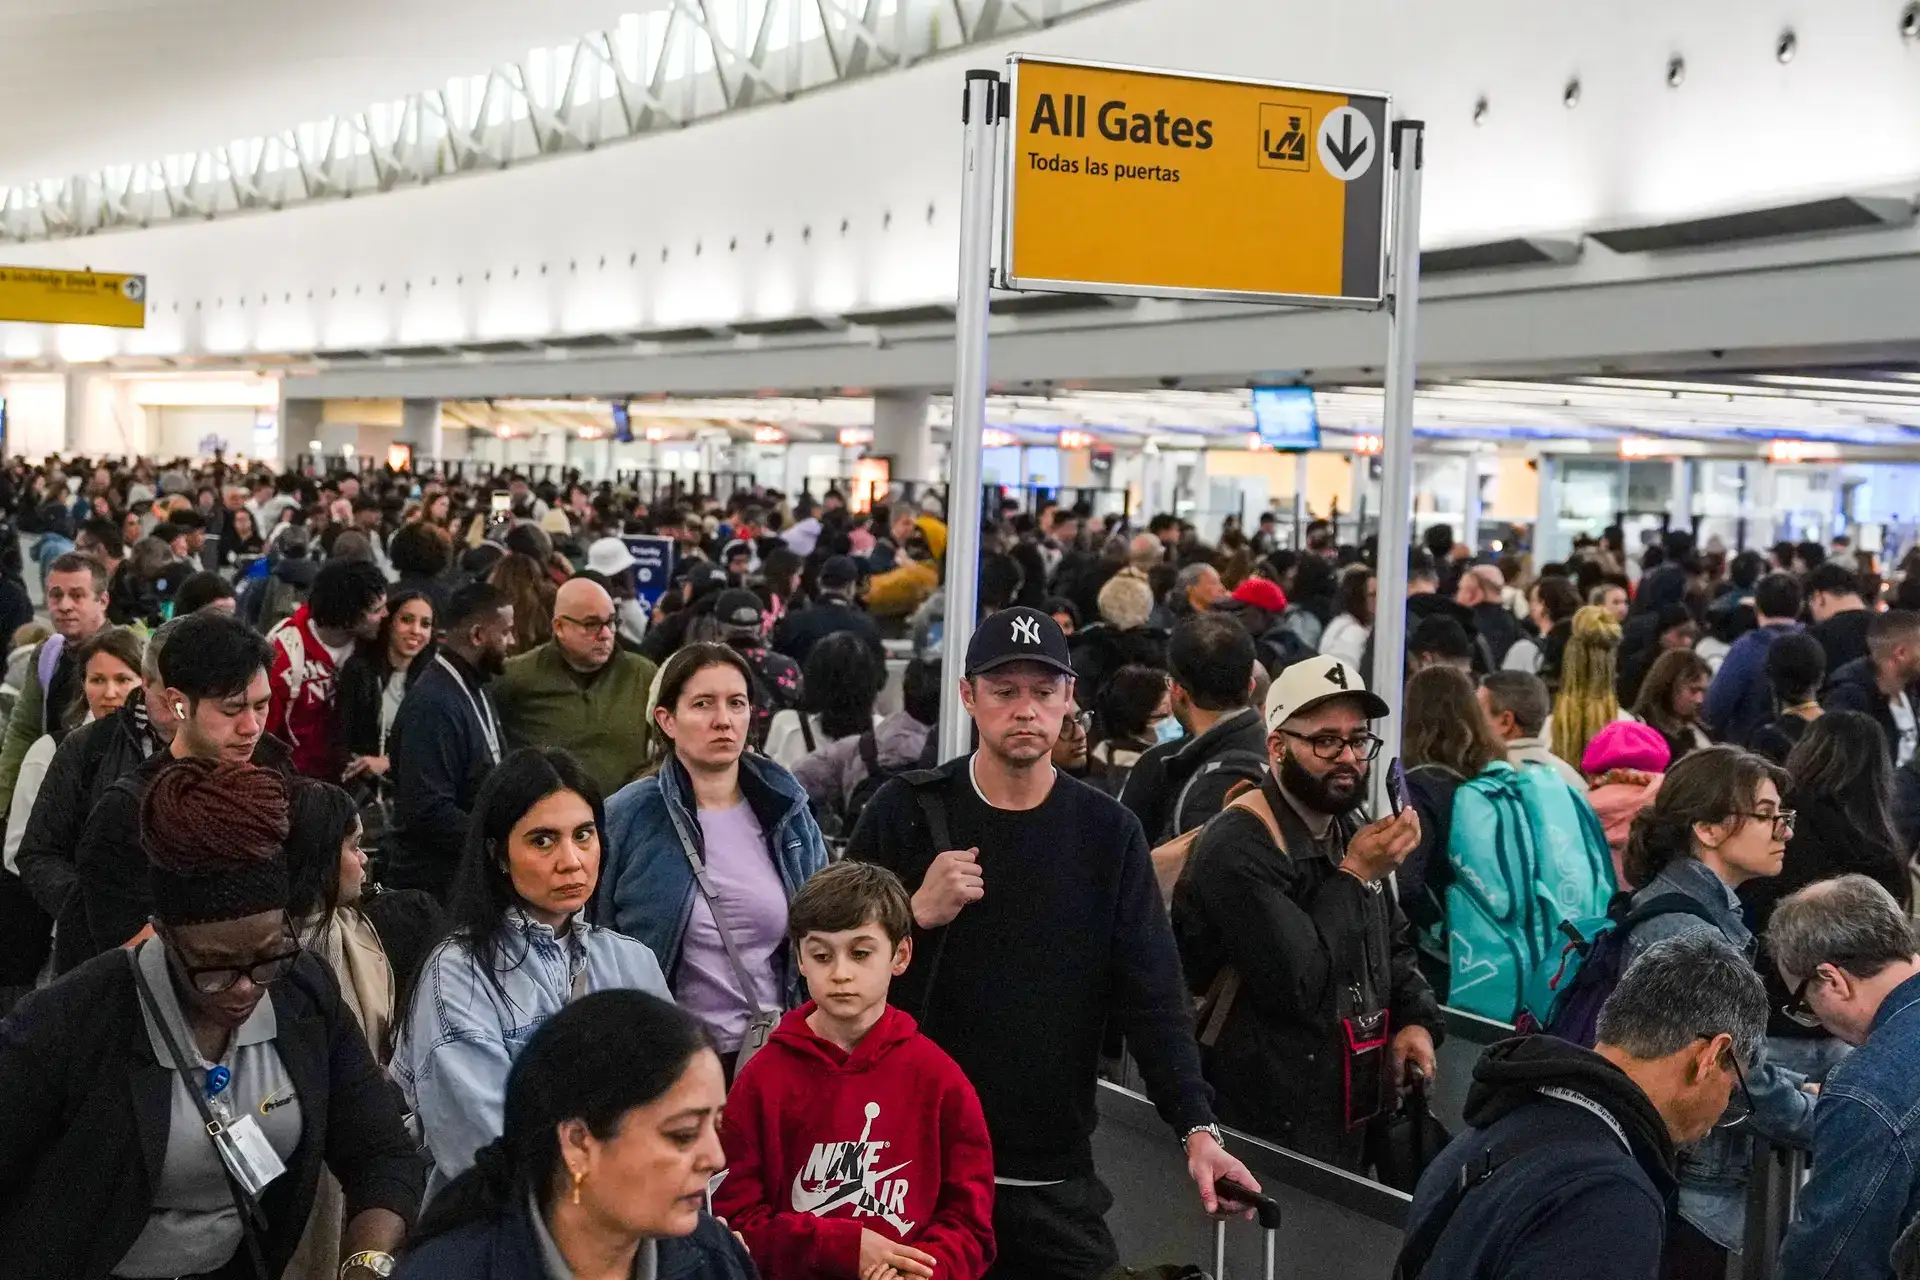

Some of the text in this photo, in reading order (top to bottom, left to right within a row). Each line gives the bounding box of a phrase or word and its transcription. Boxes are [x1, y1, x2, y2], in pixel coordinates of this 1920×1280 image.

[1029, 93, 1213, 149] All Gates
[1028, 152, 1180, 182] Todas las puertas
[1011, 615, 1041, 645] NY
[1597, 1105, 1619, 1128] Speak
[852, 1179, 909, 1218] AIR
